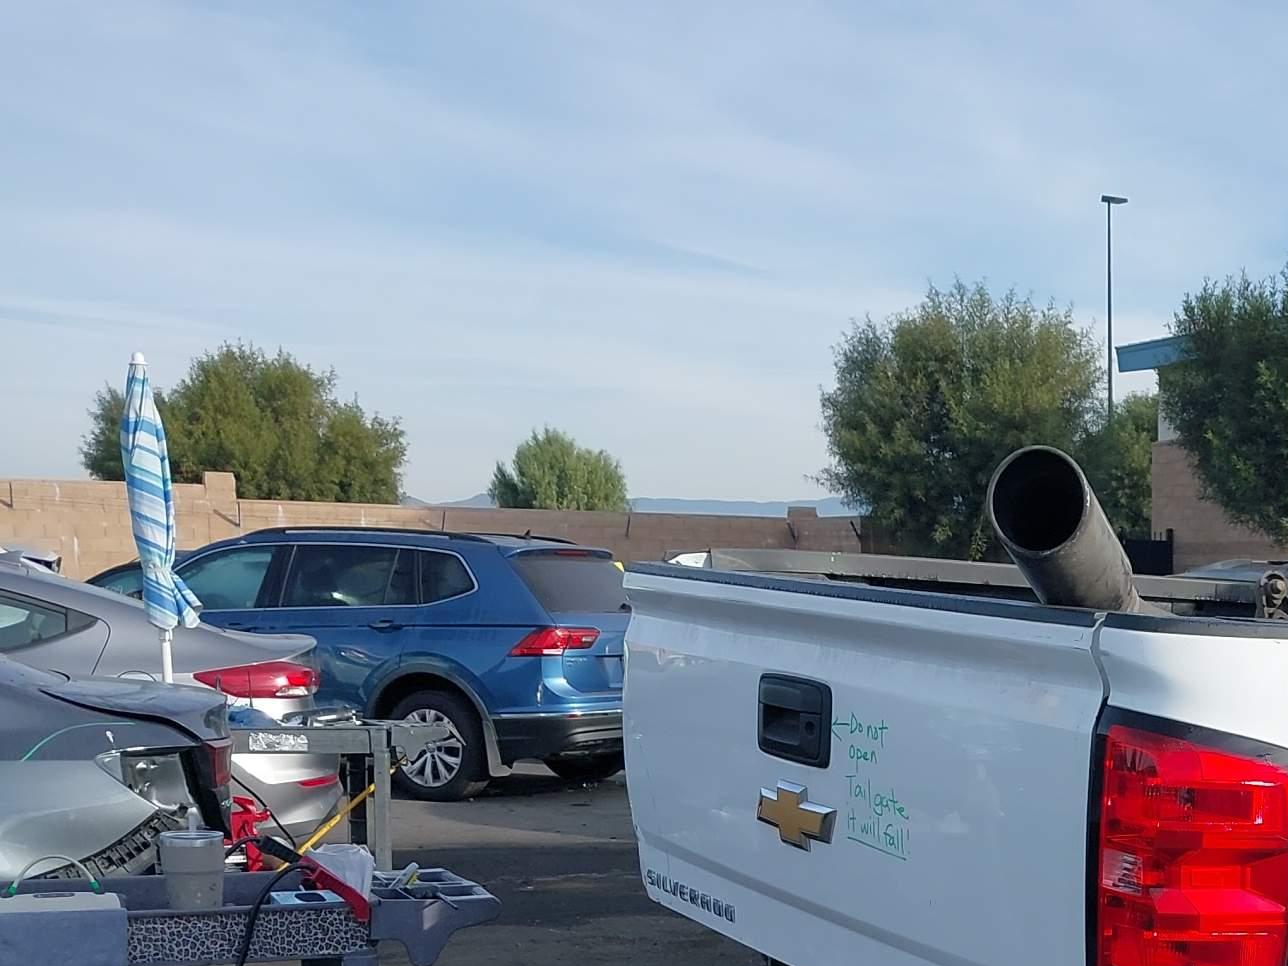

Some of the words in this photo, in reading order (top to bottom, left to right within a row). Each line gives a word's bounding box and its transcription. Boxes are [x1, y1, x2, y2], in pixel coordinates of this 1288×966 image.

[850, 712, 863, 734] Do
[867, 720, 888, 748] not
[861, 816, 880, 842] will
[647, 869, 736, 924] SILVERADO
